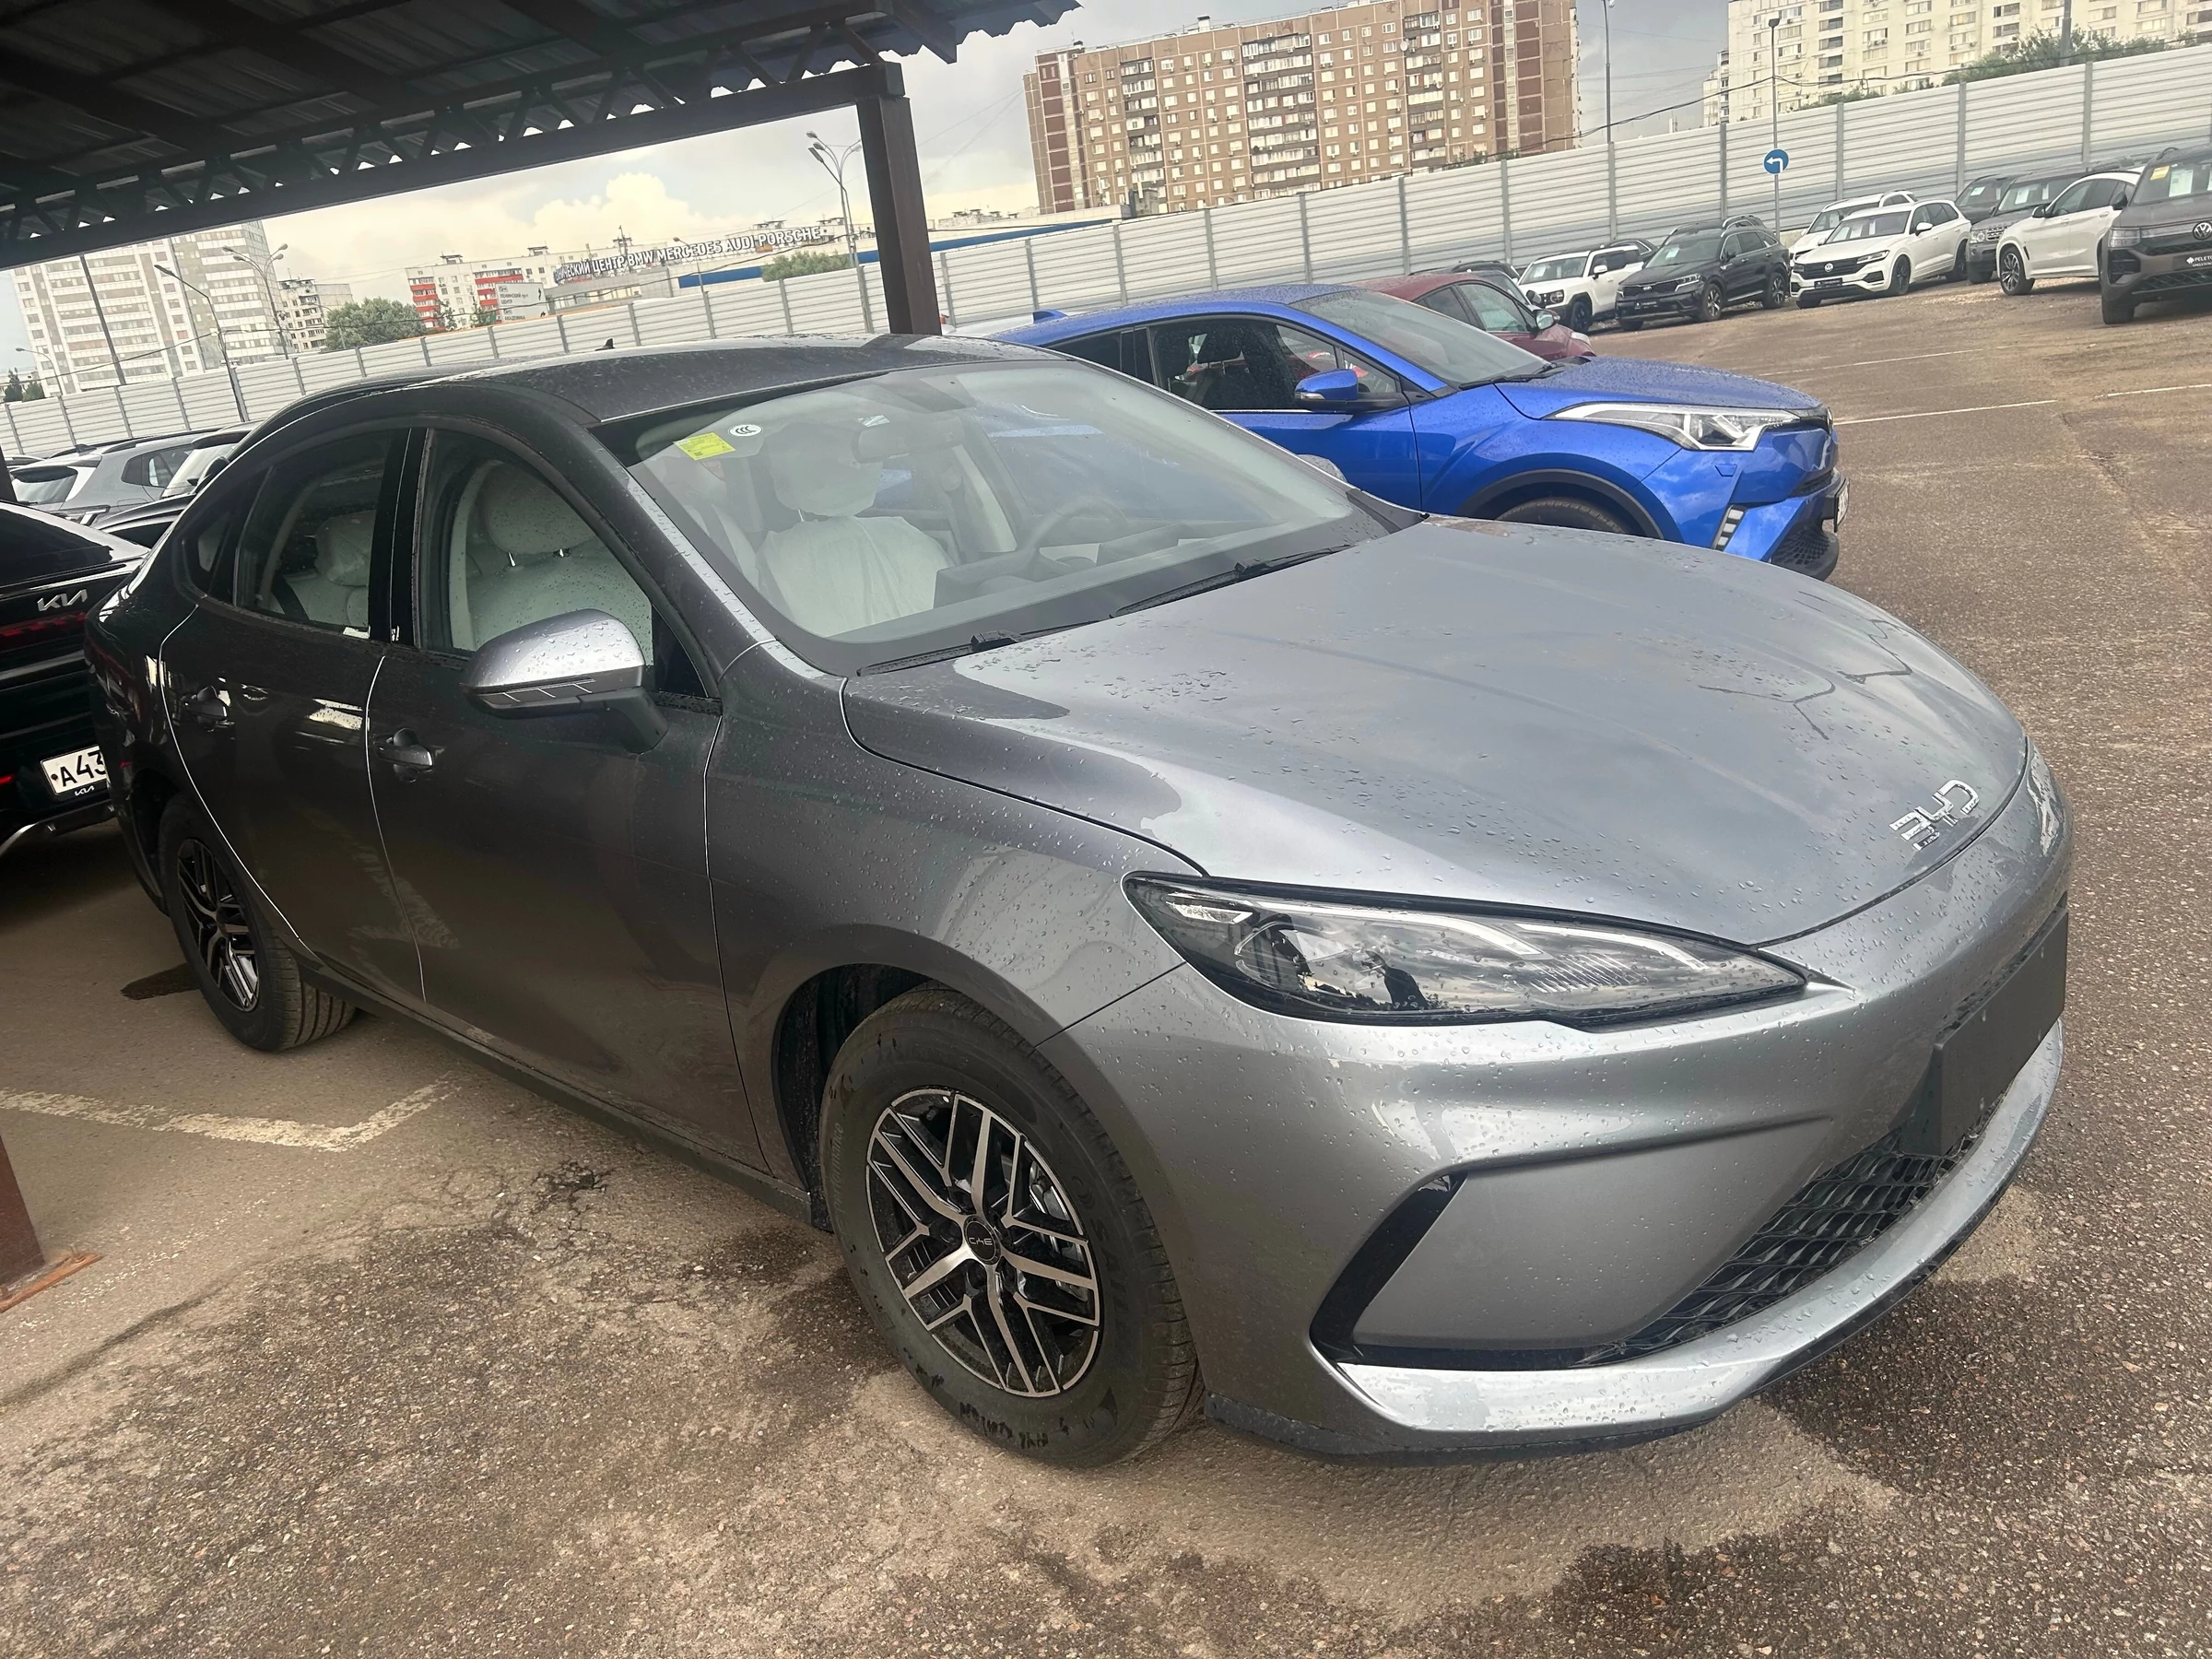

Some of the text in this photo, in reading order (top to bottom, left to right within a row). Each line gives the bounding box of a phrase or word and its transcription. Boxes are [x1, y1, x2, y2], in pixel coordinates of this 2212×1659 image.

[593, 255, 626, 276] ЦЕНТР
[627, 249, 655, 266] BMW
[657, 240, 723, 262] MERCEDES
[725, 235, 755, 252] AUDI
[758, 226, 821, 247] PORSCHE
[37, 589, 88, 612] KIA
[1889, 780, 1979, 851] BYD
[969, 1237, 993, 1246] BYD
